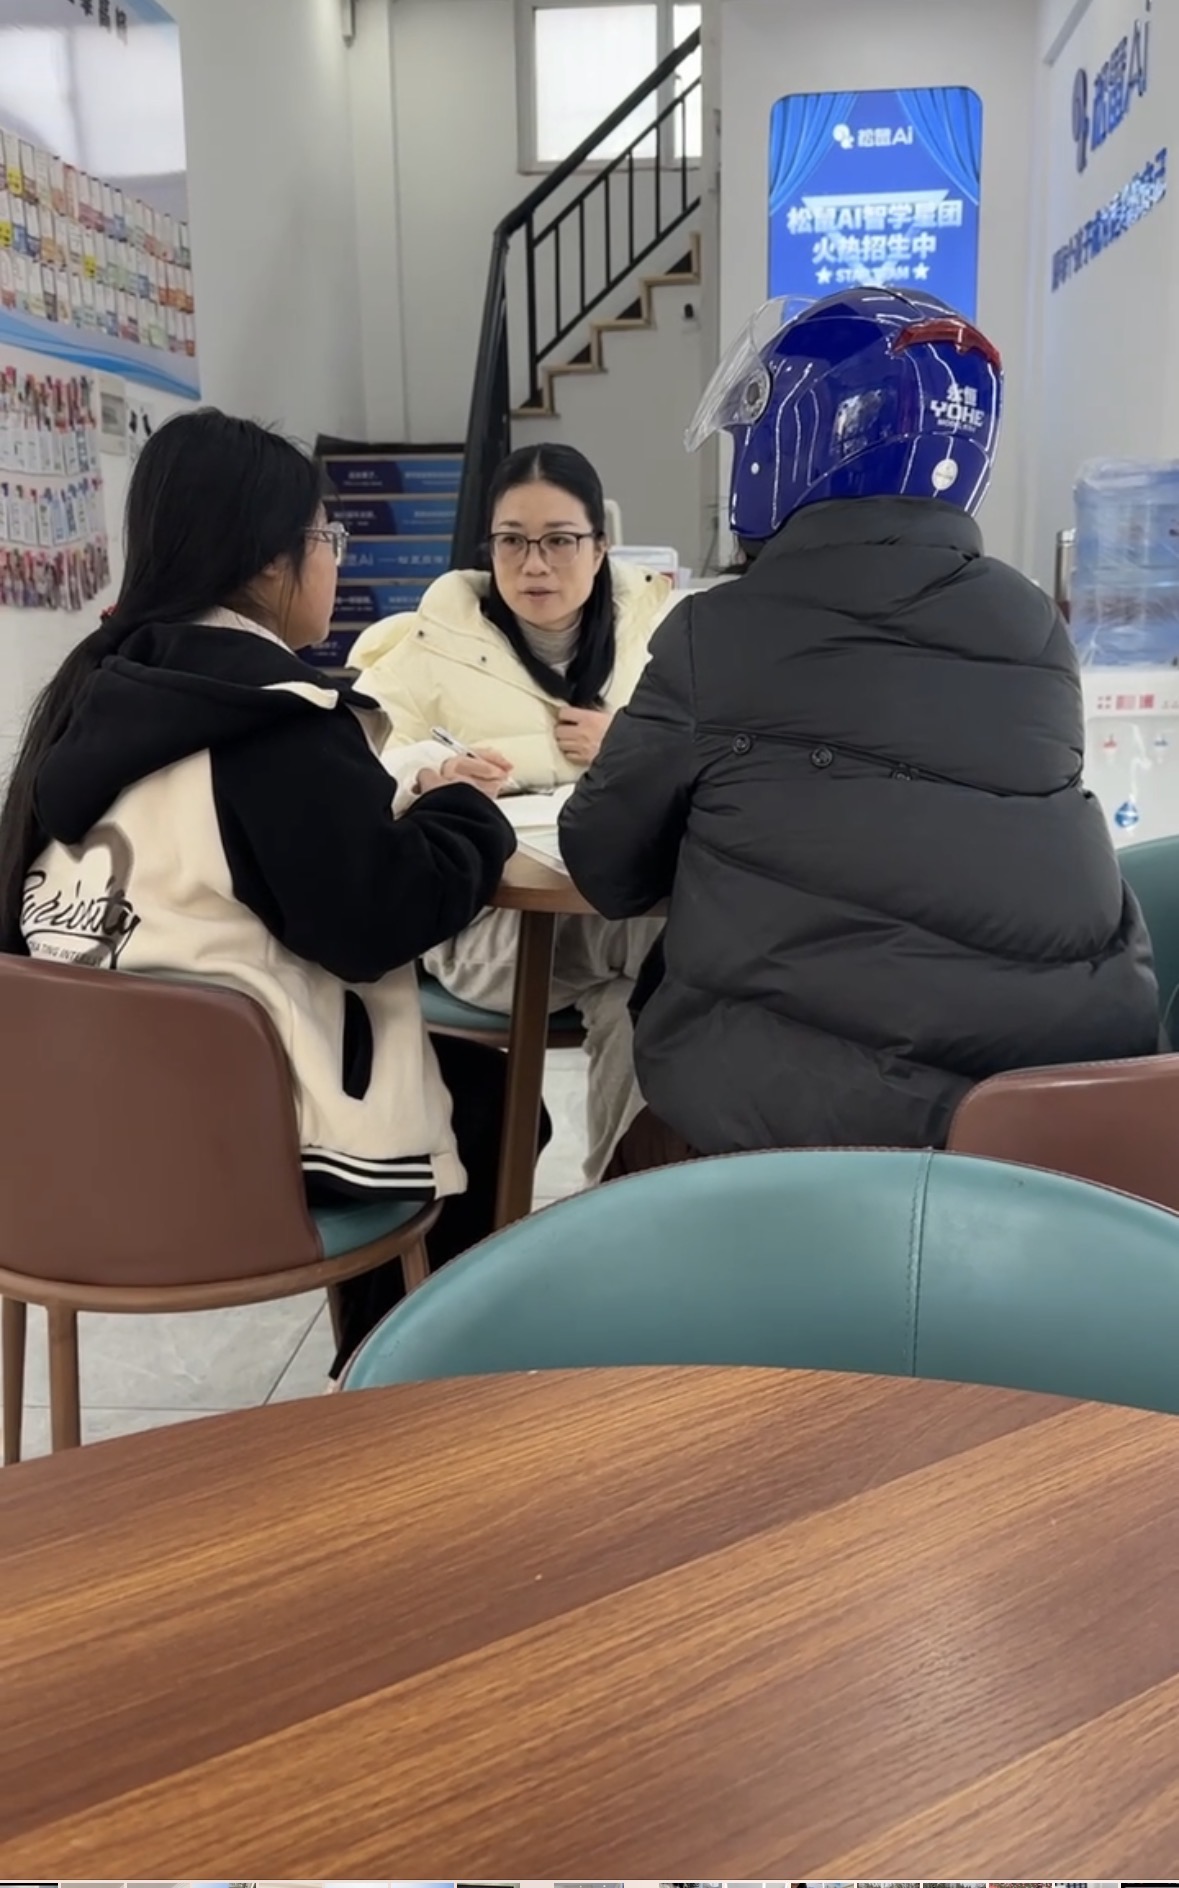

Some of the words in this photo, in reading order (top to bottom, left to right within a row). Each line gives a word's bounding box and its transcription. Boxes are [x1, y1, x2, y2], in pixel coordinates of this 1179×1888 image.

[812, 231, 937, 265] 火热招生中
[930, 400, 985, 427] YOHE
